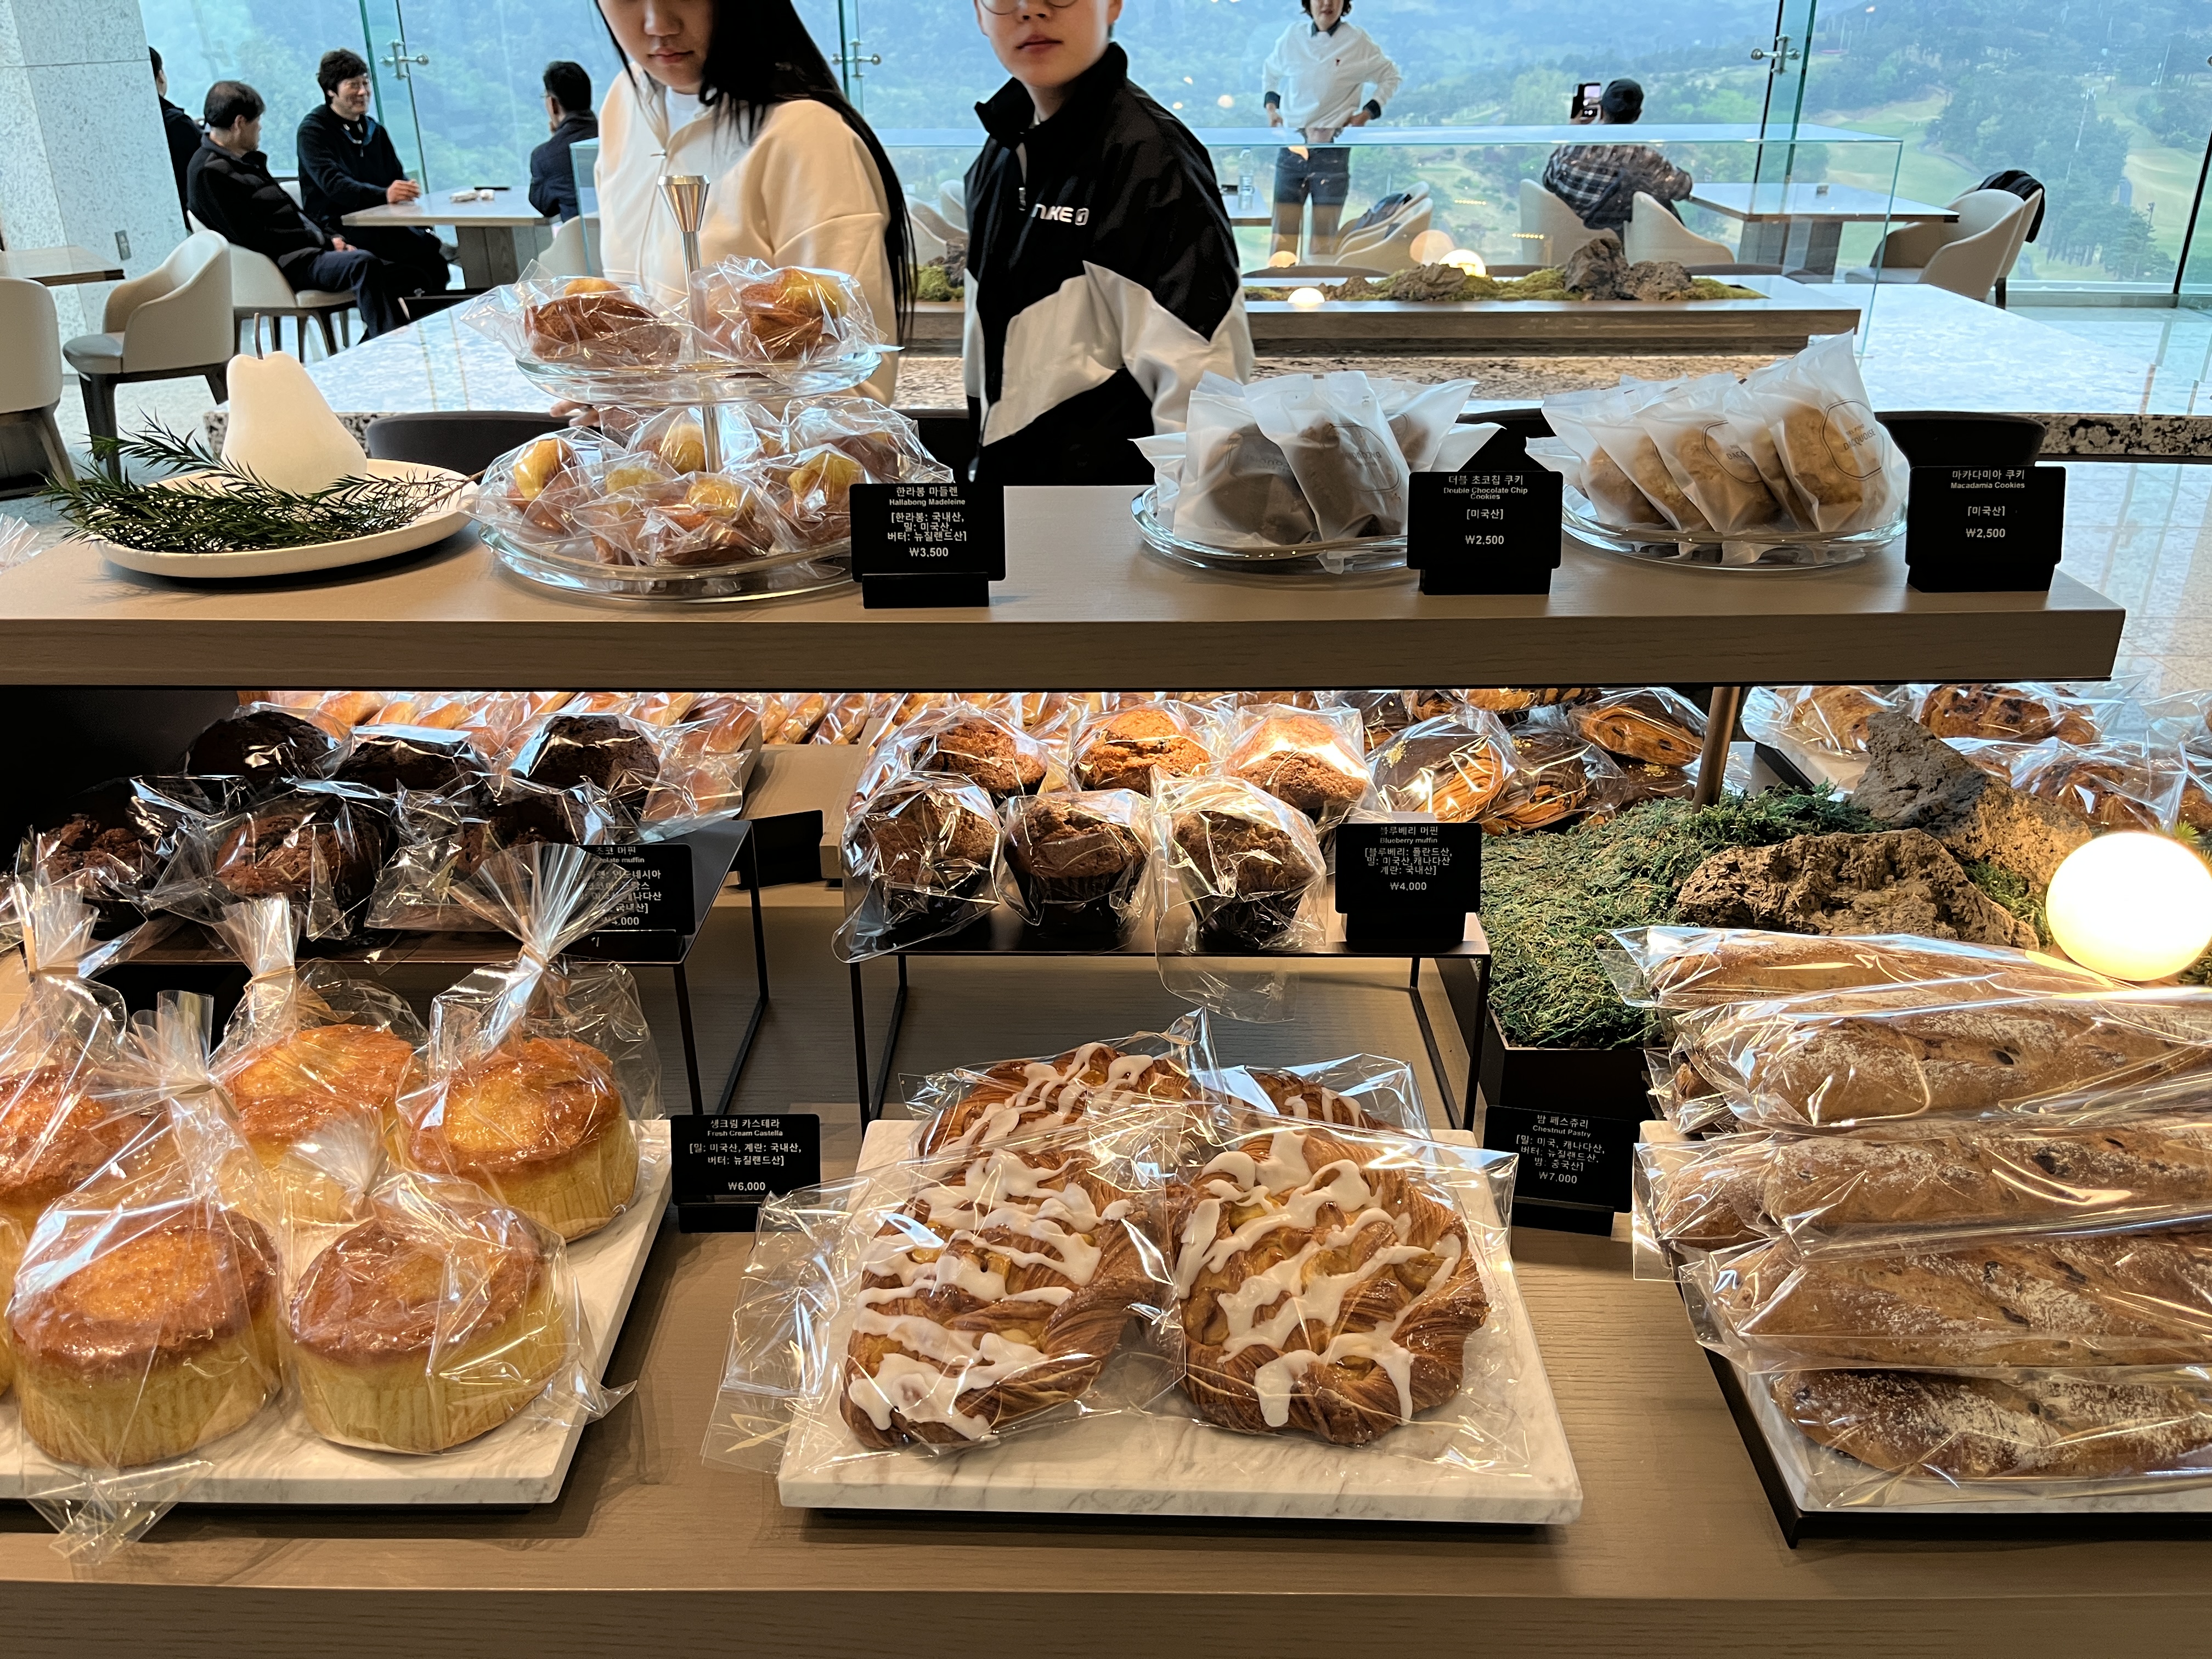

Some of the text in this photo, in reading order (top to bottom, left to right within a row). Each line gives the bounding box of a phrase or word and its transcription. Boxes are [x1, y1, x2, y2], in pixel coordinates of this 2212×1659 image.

[1843, 428, 1876, 450] DACQUOISE
[1953, 470, 2024, 479] 마카다미아 쿠키
[1449, 475, 1522, 485] 더블 초코칩 쿠키
[896, 487, 958, 496] 한라봉 마들렌
[1467, 509, 1503, 520] [미국산]
[1968, 506, 2005, 516] [미국산]
[891, 512, 964, 523] [한라봉: 국내산,
[904, 522, 916, 532] 밀:
[888, 531, 966, 541] 버터: 뉴질랜드산]
[1966, 528, 2005, 538] ₩2,500
[909, 548, 948, 557] ₩3,500
[1380, 826, 1437, 835] 블루베리 머핀
[618, 847, 635, 855] 머핀
[1365, 848, 1408, 857] [블루베리:
[1367, 856, 1378, 866] 밀:
[1381, 865, 1436, 875] 계란: 국내산]
[1390, 882, 1426, 890] ₩4,000
[710, 1119, 780, 1128] 생크림 카스테라
[1538, 1115, 1546, 1124] 밤
[1533, 1125, 1566, 1134] Chestnut
[690, 1143, 801, 1154] [밀: 미국산, 계란: 국내산,
[1516, 1135, 1604, 1154] [밀: 미국, 캐나다산,
[1521, 1146, 1542, 1155] 버터:
[708, 1155, 784, 1166] 버터: 뉴질랜드산]
[1552, 1159, 1584, 1171] 중국산]
